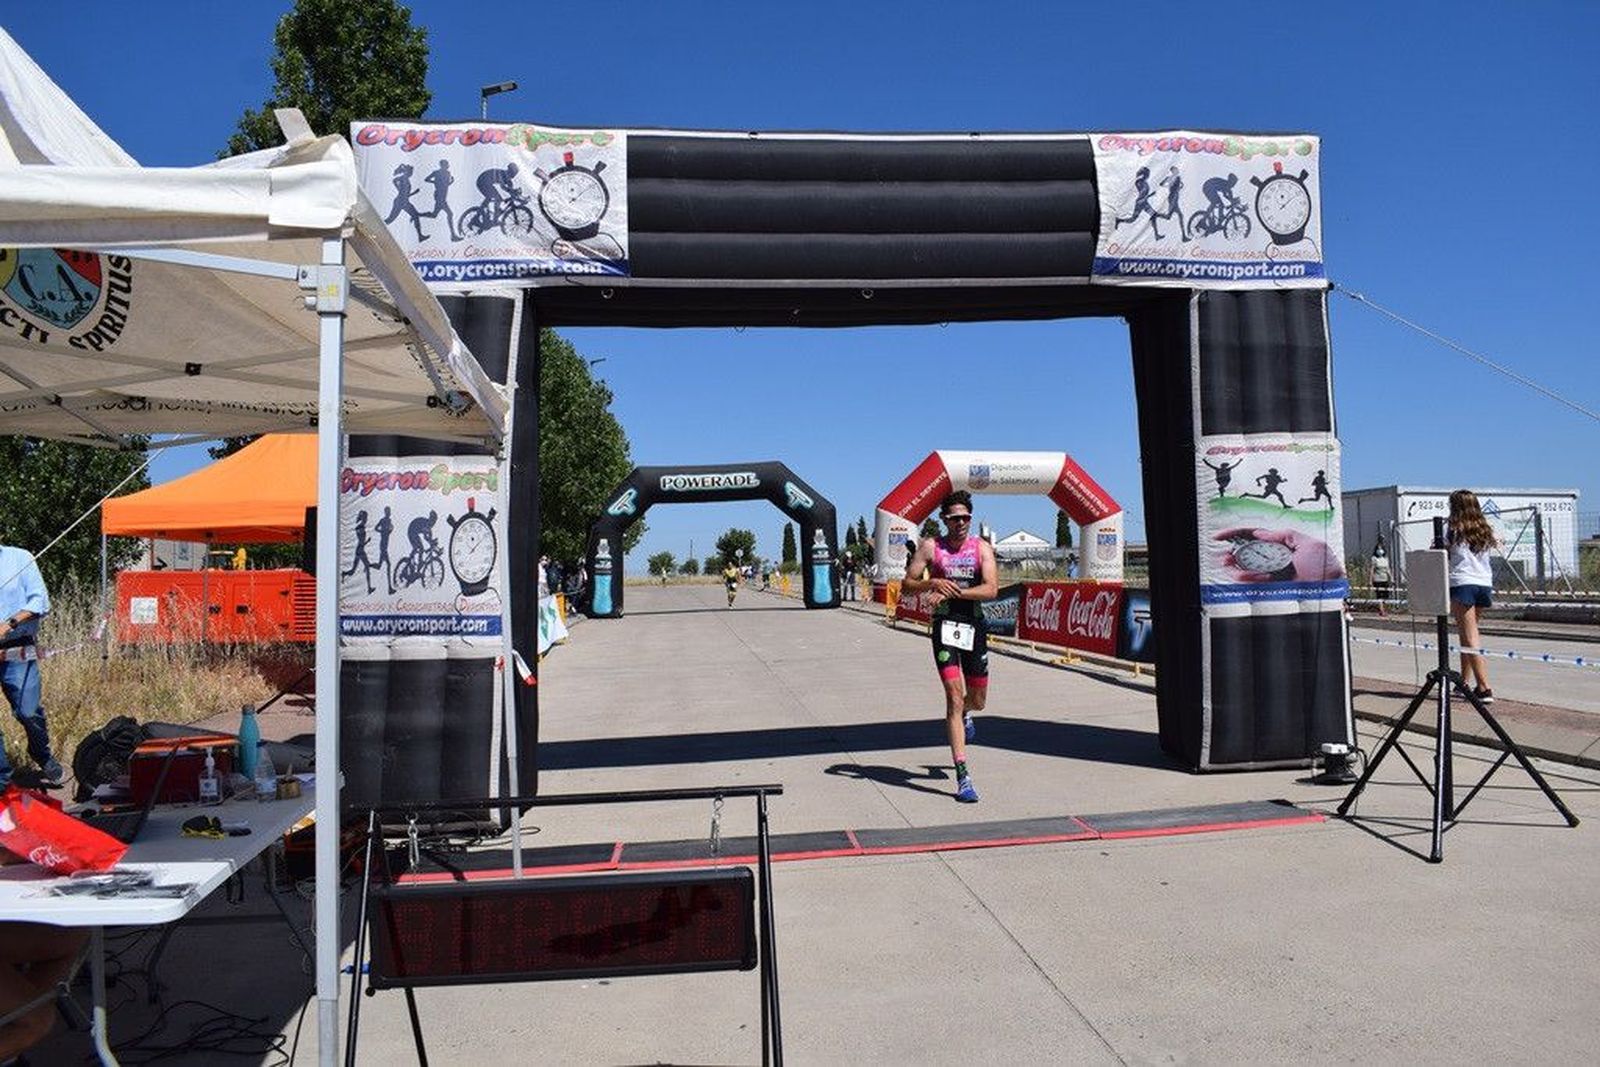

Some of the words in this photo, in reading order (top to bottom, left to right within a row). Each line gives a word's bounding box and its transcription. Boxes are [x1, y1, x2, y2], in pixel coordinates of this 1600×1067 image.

[1119, 261, 1306, 279] www.orycronsport.com
[661, 472, 760, 490] POWERADE
[342, 617, 488, 634] www.orycronsport.com
